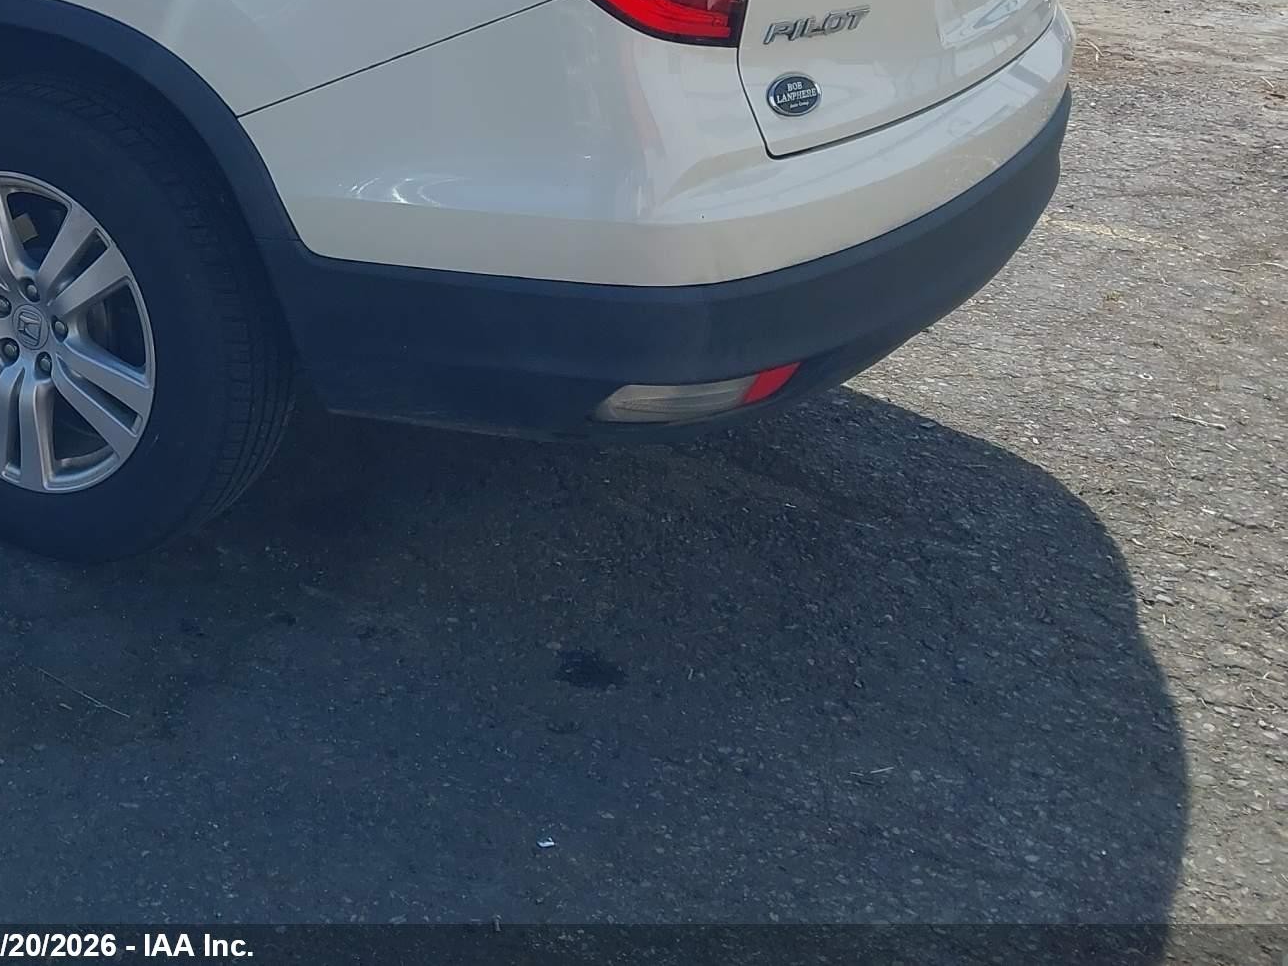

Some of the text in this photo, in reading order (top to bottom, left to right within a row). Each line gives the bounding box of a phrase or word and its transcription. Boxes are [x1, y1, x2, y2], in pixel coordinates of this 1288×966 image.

[763, 5, 870, 45] PILOT
[787, 81, 803, 92] BOB
[776, 88, 817, 104] LANPHERE
